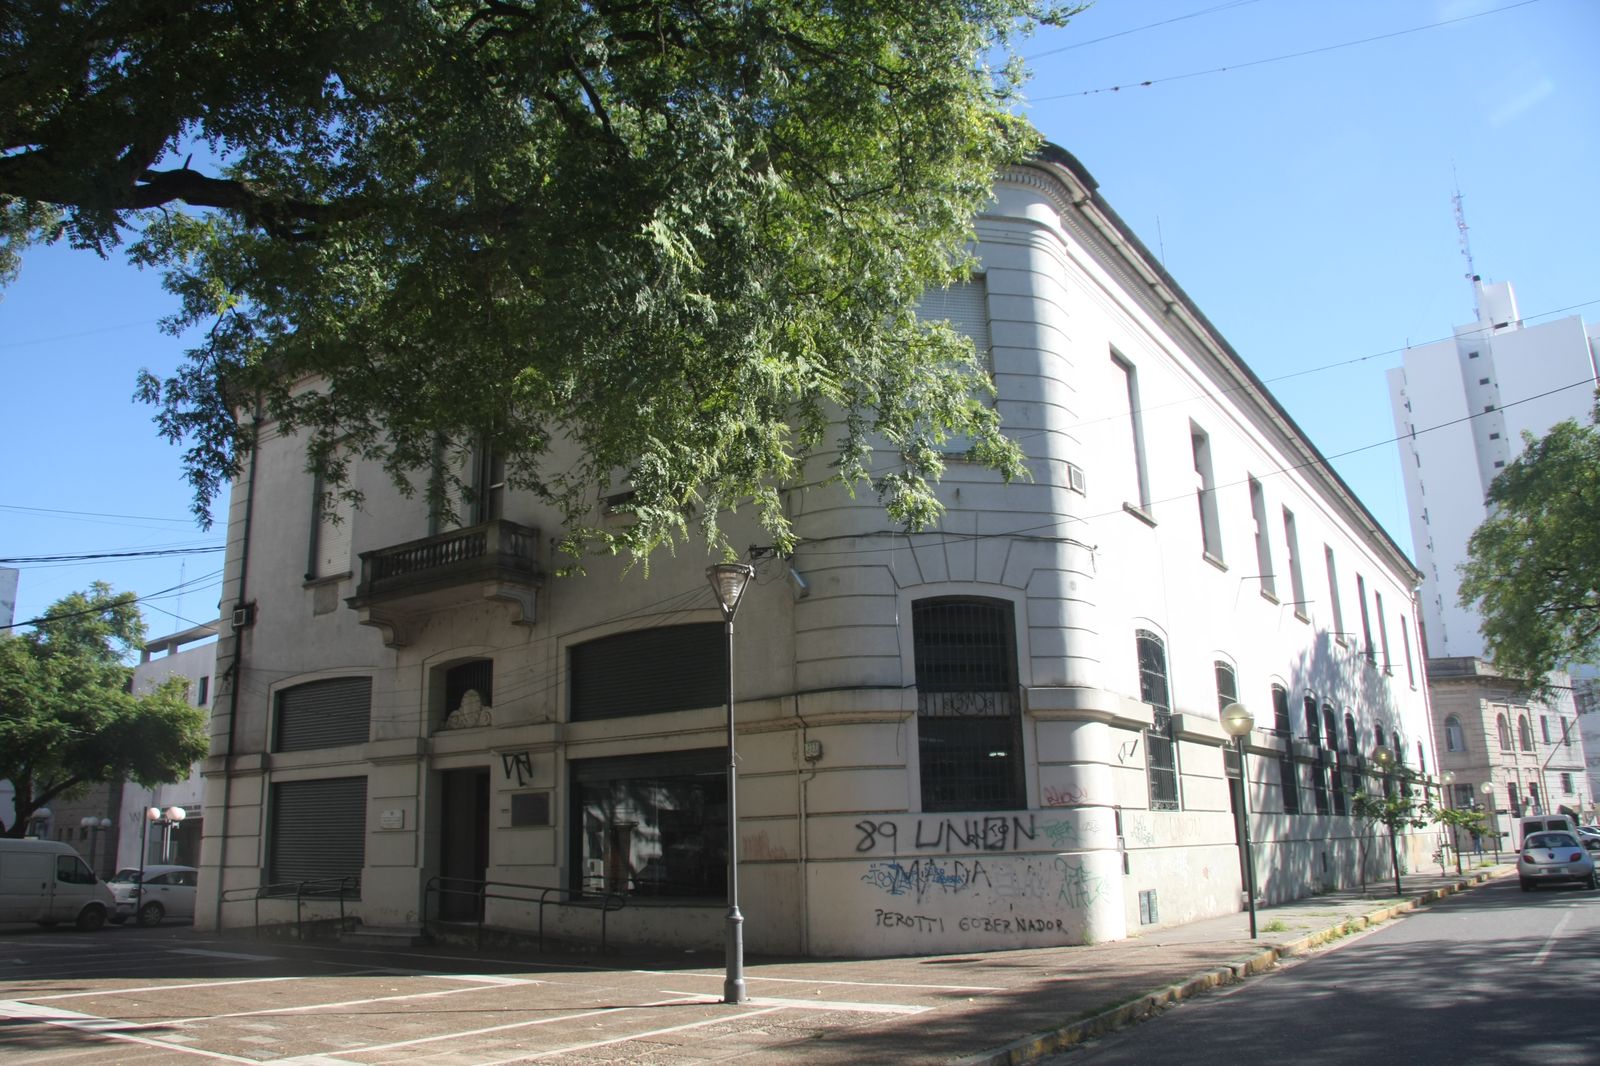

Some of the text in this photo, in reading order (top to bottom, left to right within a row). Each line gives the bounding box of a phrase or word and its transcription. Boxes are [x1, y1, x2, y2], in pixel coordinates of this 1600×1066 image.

[856, 820, 897, 854] 89
[875, 909, 1068, 934] PEROTTI GOBERNADOR
